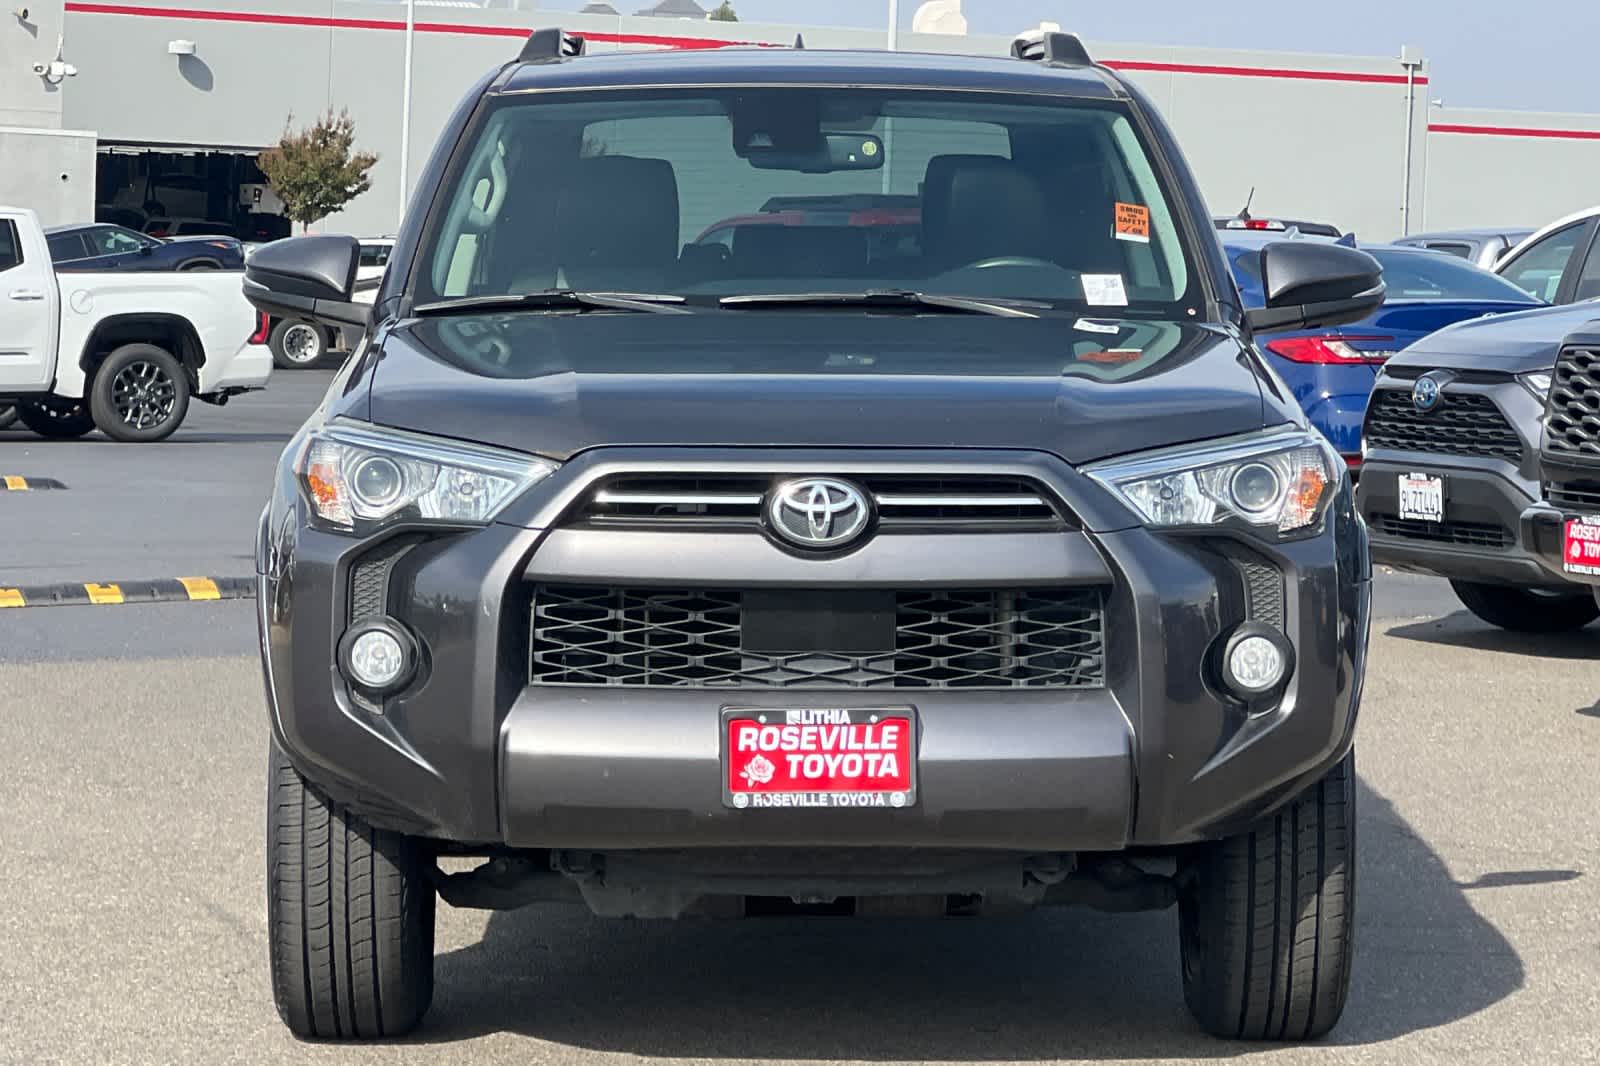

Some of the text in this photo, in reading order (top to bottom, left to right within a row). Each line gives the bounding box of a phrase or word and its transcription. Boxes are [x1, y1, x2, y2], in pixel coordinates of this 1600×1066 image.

[1120, 206, 1143, 215] SMOG
[1118, 216, 1146, 225] SAFETY
[802, 710, 850, 724] LITHIA
[738, 726, 899, 751] ROSEVILLE
[786, 753, 899, 778] TOYOTA
[753, 793, 885, 807] ROSEVILLE TOYOTA
